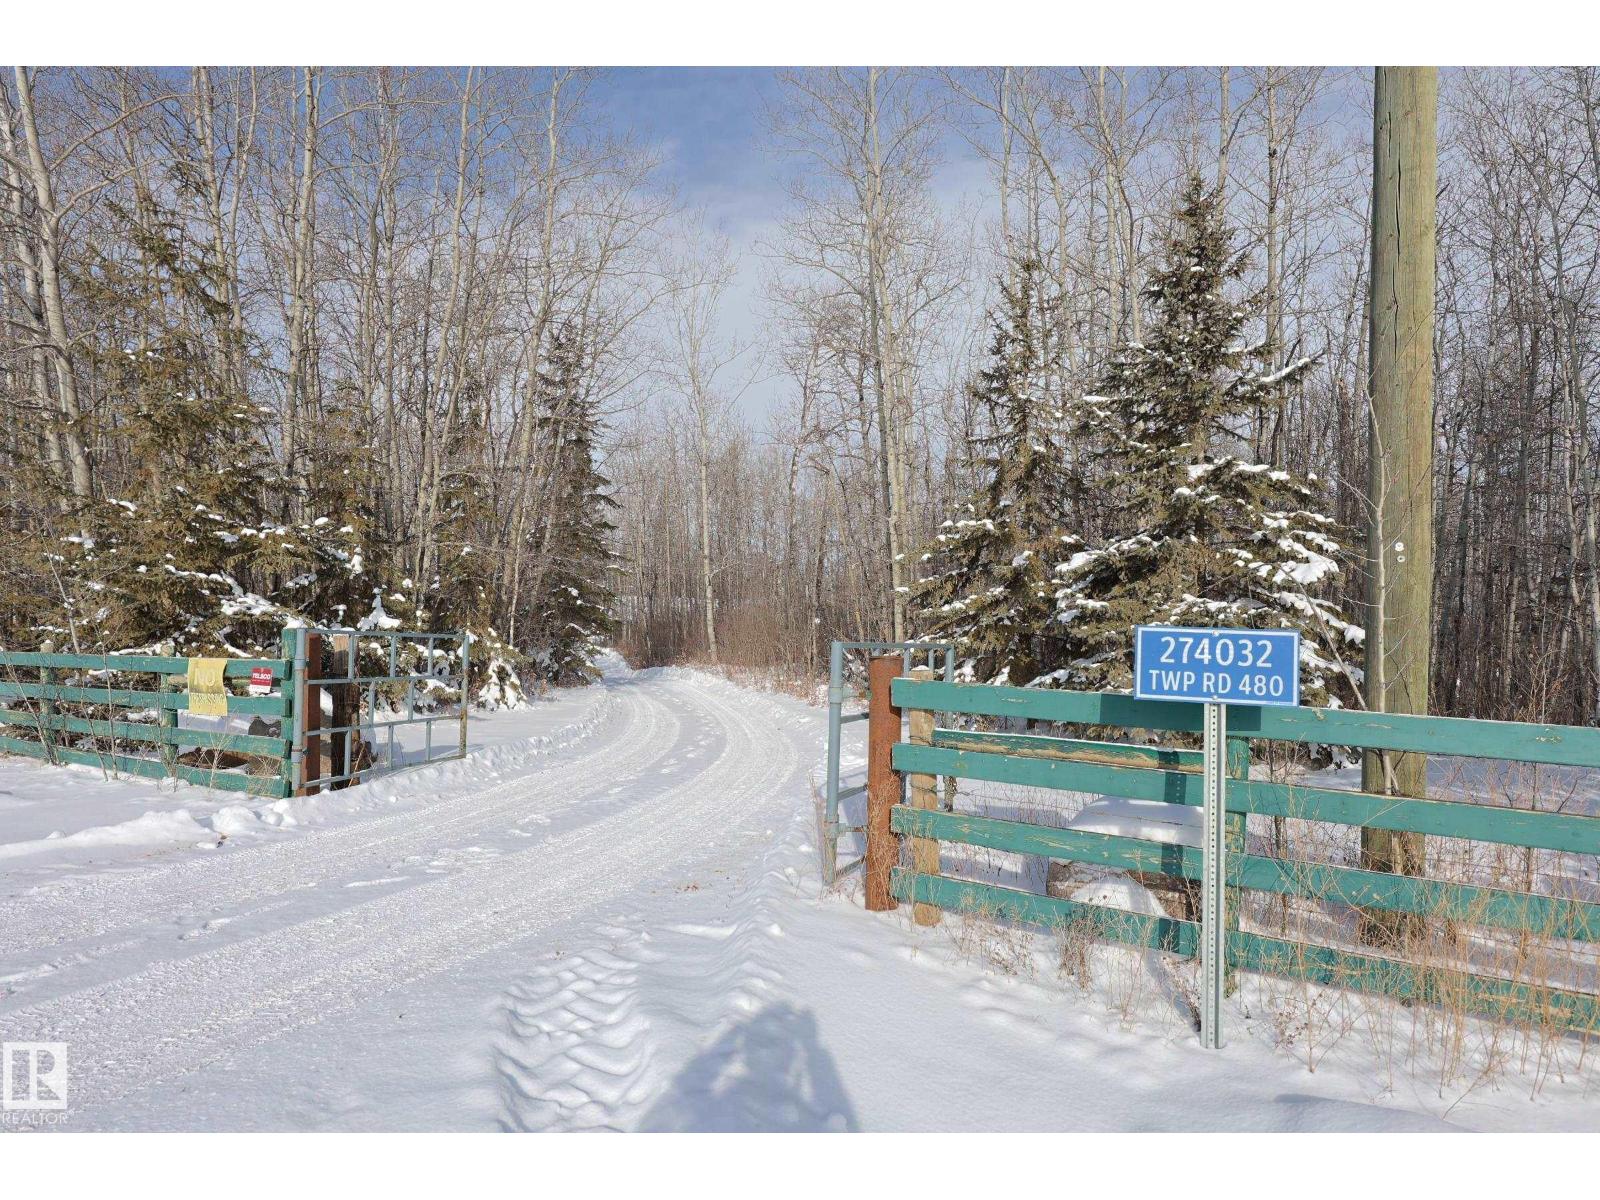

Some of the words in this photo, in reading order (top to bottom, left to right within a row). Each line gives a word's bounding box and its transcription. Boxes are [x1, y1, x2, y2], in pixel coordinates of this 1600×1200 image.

[1160, 636, 1273, 668] 274032
[193, 667, 216, 687] NO
[1149, 669, 1196, 692] TWP
[1202, 672, 1232, 694] RD
[1238, 674, 1284, 697] 480
